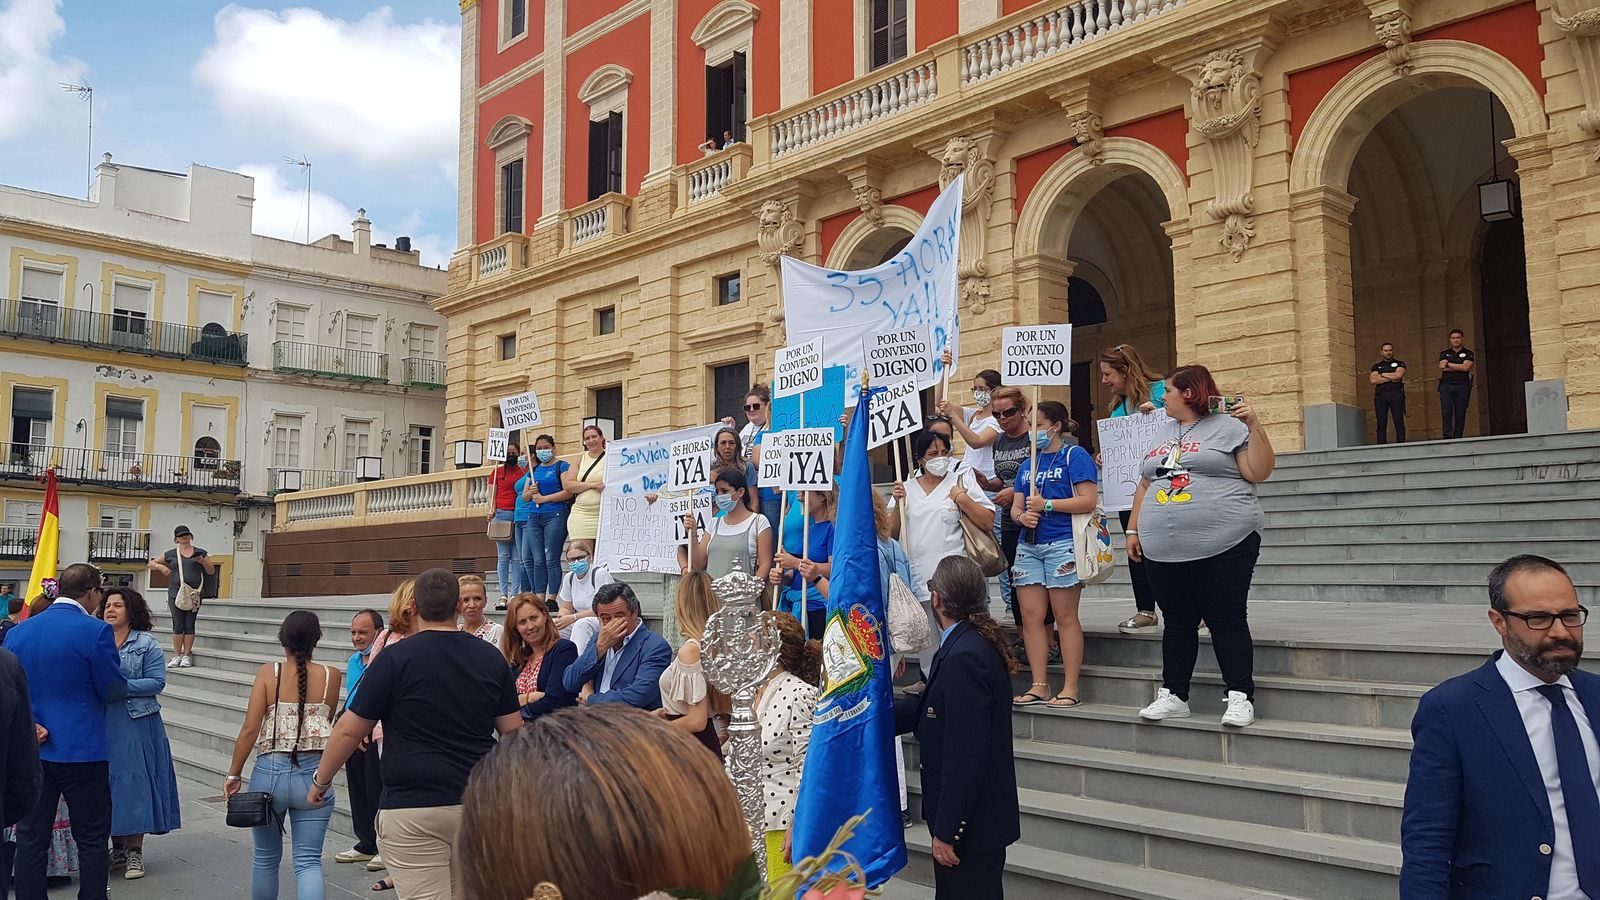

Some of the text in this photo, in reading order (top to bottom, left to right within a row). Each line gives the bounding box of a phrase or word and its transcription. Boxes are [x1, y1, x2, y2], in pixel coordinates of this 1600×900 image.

[826, 271, 883, 313] 35
[877, 330, 916, 345] POR UN
[1016, 330, 1056, 342] POR UN
[786, 343, 814, 360] POR UN
[870, 342, 926, 360] CONVENIO
[1007, 343, 1065, 356] CONVENIO
[779, 353, 819, 373] CONVENIO
[873, 356, 927, 378] DIGNO
[1007, 359, 1064, 377] DIGNO
[779, 366, 819, 390] DIGNO
[507, 395, 530, 406] POR UN
[876, 380, 915, 407] HORAS
[504, 402, 536, 415] CONVENIO
[507, 411, 538, 427] DIGNO
[784, 432, 832, 448] 35 HORAS
[1113, 427, 1133, 442] SAN
[672, 445, 681, 457] 35
[682, 439, 710, 455] HORAS
[674, 455, 707, 486] ¡YA
[788, 450, 829, 485] ¡YA
[615, 497, 637, 513] NO
[669, 502, 679, 513] 35
[613, 528, 626, 541] DE
[631, 529, 651, 543] LOS
[617, 542, 642, 557] DEL
[619, 557, 650, 572] SAD
